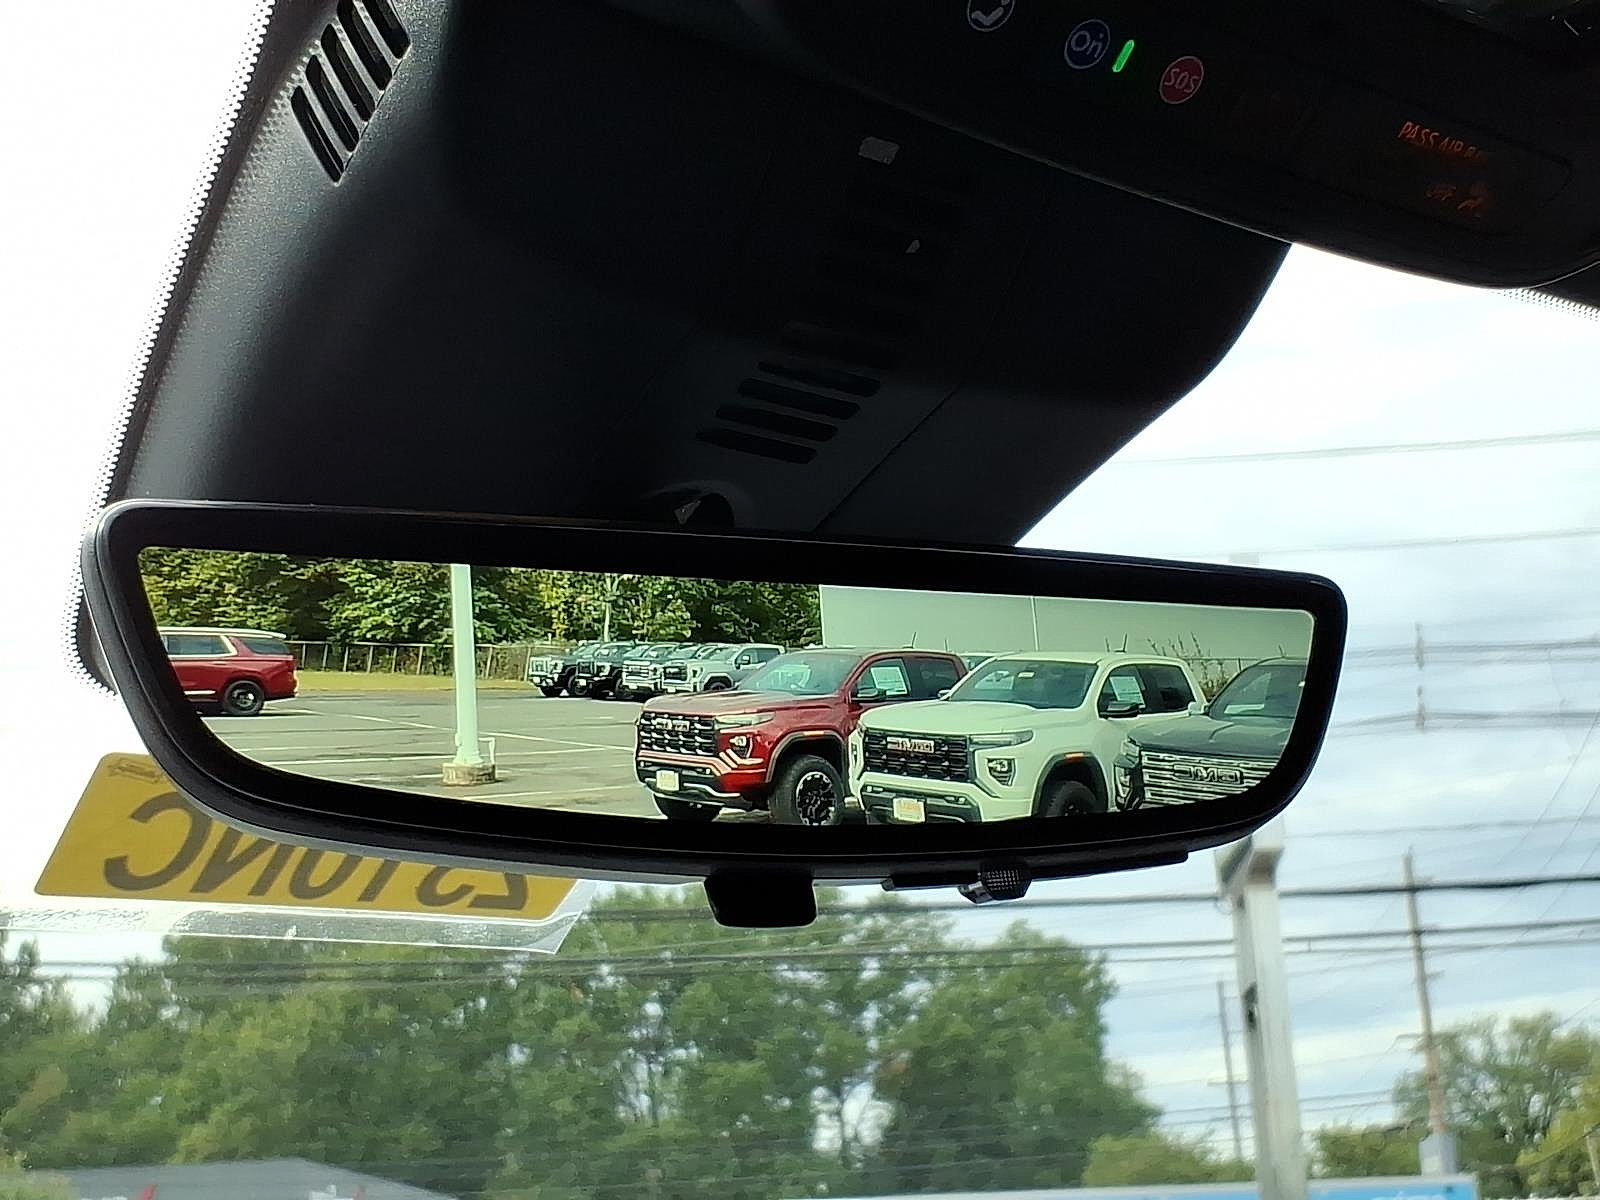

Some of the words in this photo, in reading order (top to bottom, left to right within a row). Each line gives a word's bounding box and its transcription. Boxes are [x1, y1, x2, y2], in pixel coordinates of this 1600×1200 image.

[1070, 29, 1103, 60] On
[1163, 67, 1200, 94] SOS
[1397, 119, 1440, 147] PASS
